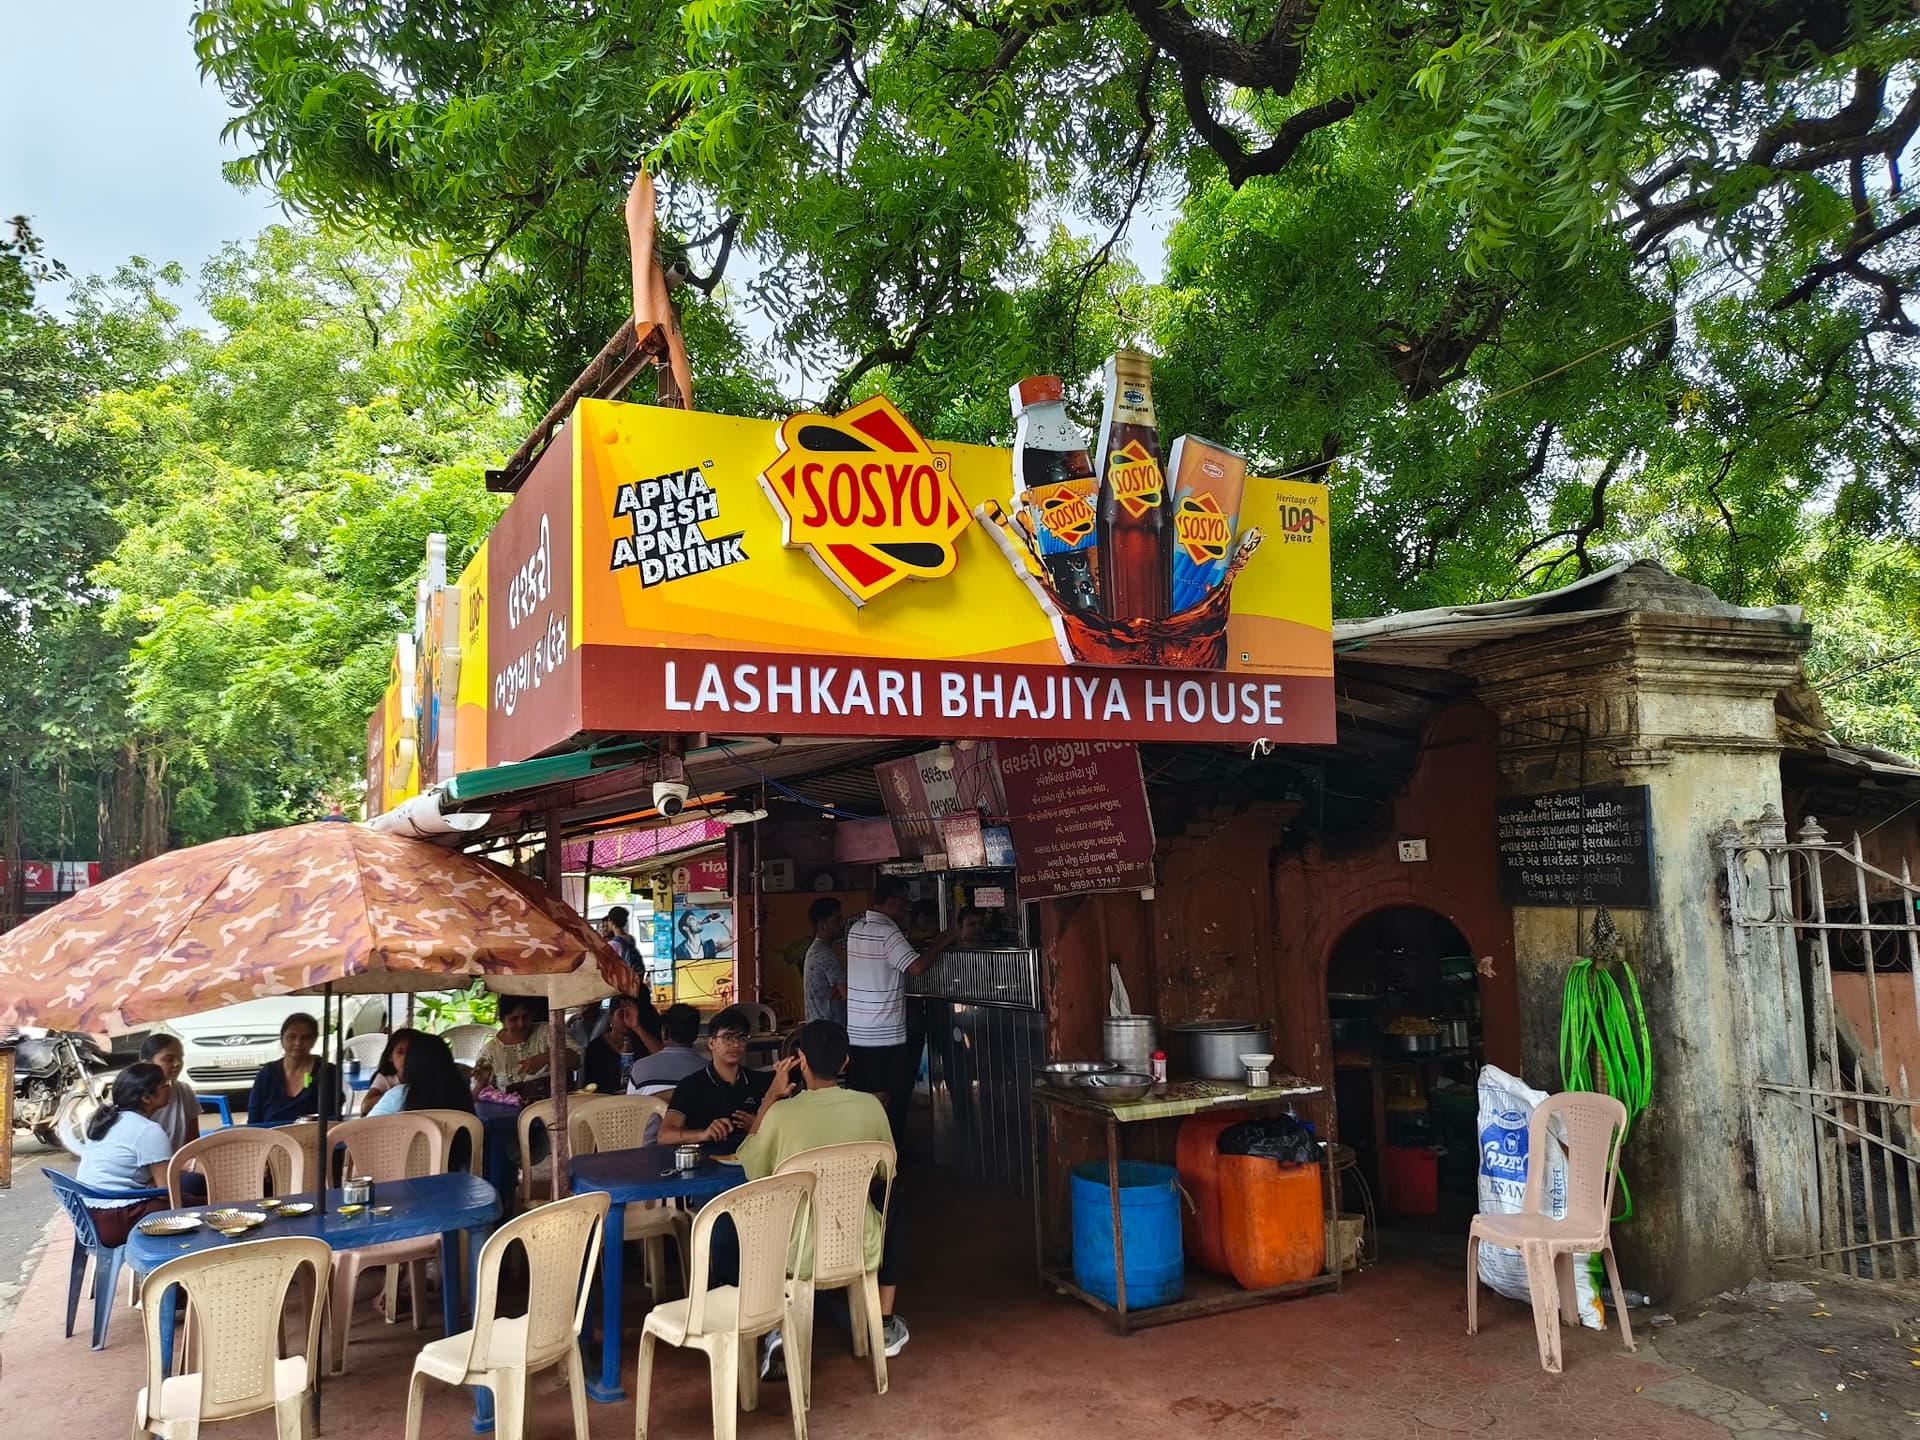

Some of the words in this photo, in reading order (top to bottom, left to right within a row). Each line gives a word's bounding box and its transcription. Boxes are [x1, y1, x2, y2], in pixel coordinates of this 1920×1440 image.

[617, 470, 711, 514] APNA
[800, 461, 941, 528] SOSYO
[1115, 464, 1156, 496] SOSYO
[635, 492, 719, 534] DESH
[1049, 499, 1086, 530] SOSYO
[1276, 493, 1307, 505] Heritage
[1308, 496, 1319, 506] Of
[1182, 515, 1225, 542] SOSYO
[1279, 505, 1315, 533] 100
[613, 523, 706, 566] APNA
[1284, 533, 1313, 544] years
[641, 537, 747, 585] DRINK
[665, 661, 923, 718] LASHKARI
[940, 672, 1130, 722] BHAJIYA
[1143, 680, 1284, 726] HOUSE
